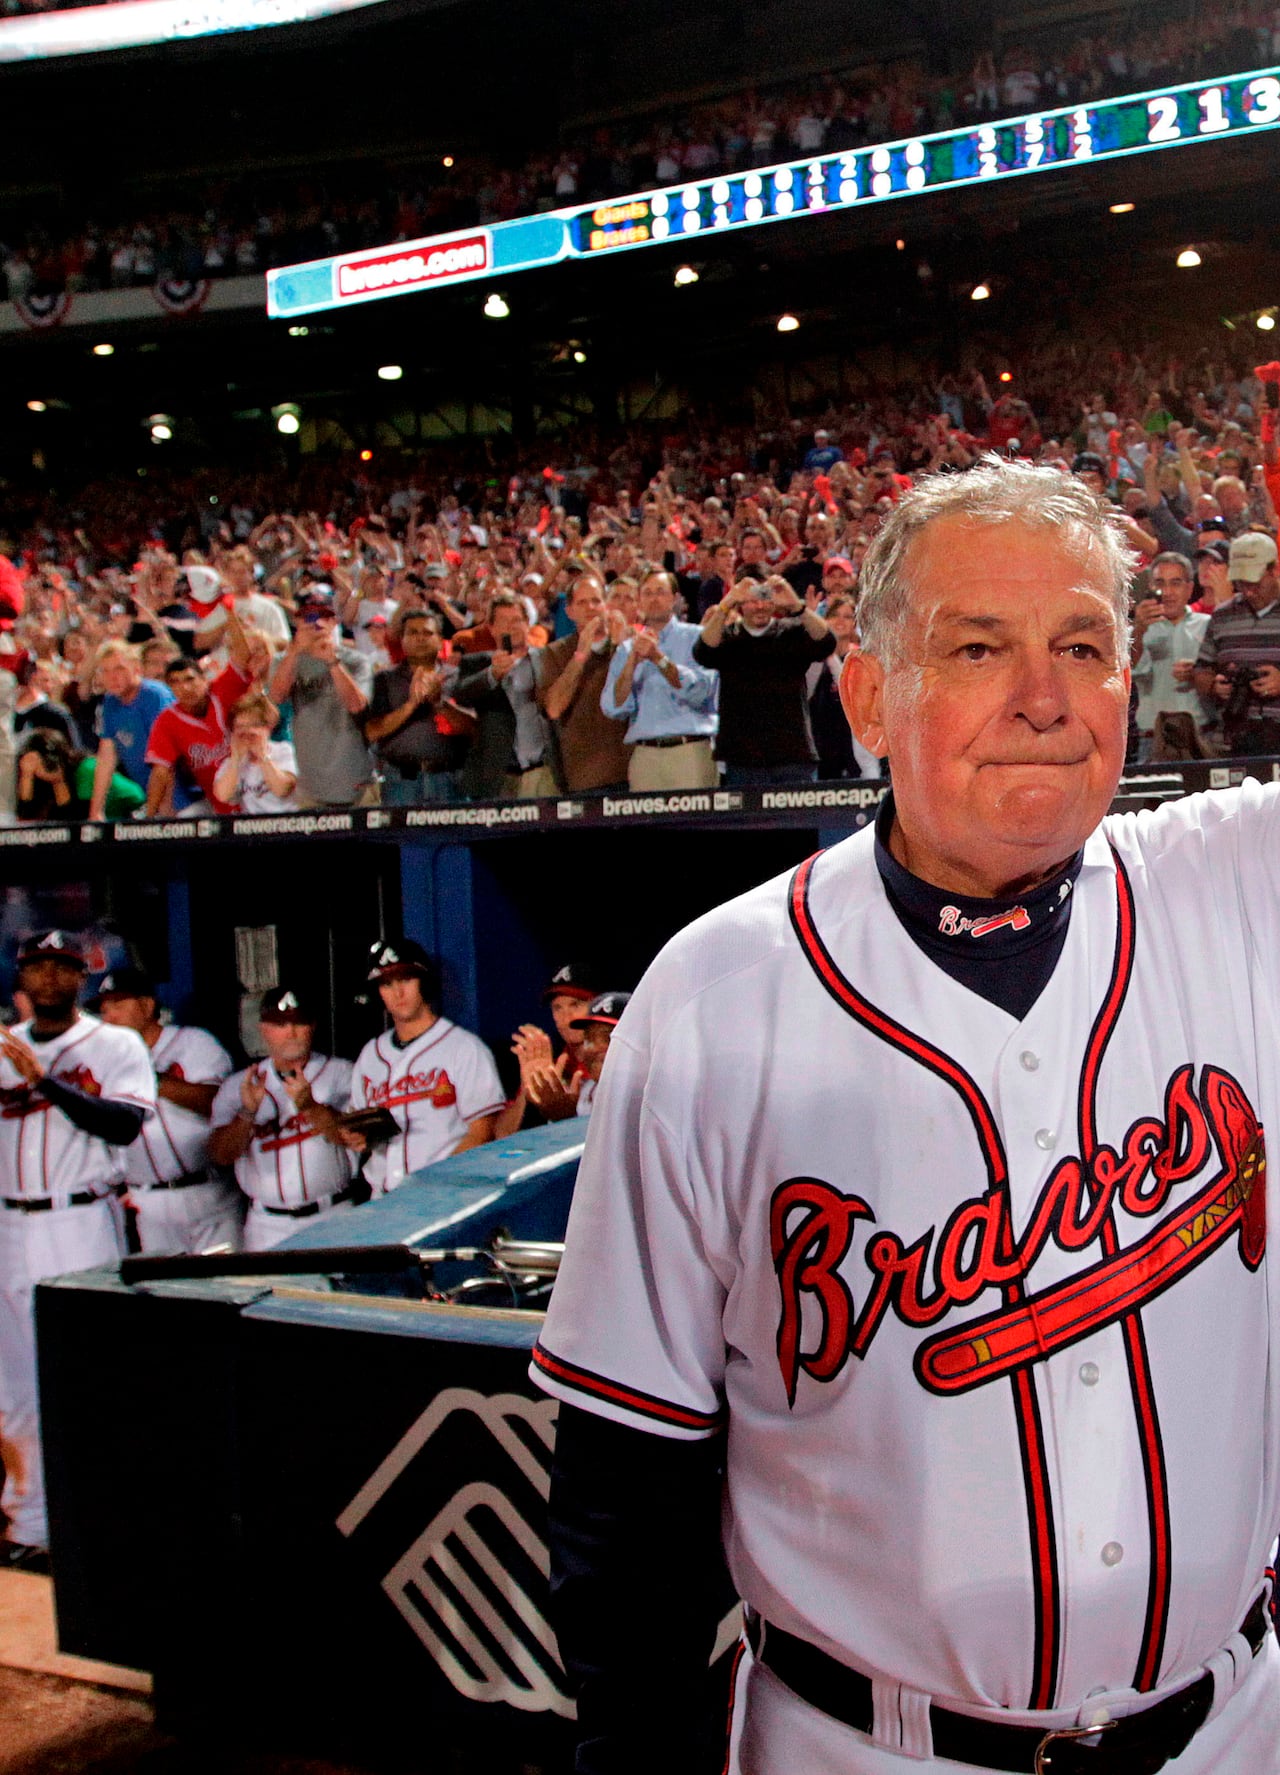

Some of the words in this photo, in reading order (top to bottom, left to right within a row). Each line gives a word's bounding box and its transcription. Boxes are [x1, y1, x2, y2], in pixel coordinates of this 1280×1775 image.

[1147, 97, 1181, 142] 2
[1198, 88, 1230, 133] 1
[651, 192, 669, 216] 0
[682, 186, 700, 210] 0
[712, 180, 730, 204] 0
[744, 174, 762, 197] 0
[774, 167, 793, 191] 0
[808, 161, 826, 185] 1
[839, 154, 857, 179] 2
[872, 148, 891, 172] 0
[905, 141, 925, 166] 0
[978, 127, 996, 152] 3
[1024, 118, 1044, 143] 5
[1073, 109, 1092, 134] 1
[590, 225, 649, 250] Braves
[651, 216, 669, 240] 0
[683, 210, 701, 233] 0
[713, 204, 730, 228] 1
[745, 198, 763, 222] 0
[775, 192, 794, 216] 0
[809, 185, 826, 209] 1
[839, 179, 858, 203] 0
[872, 172, 891, 196] 0
[906, 166, 926, 190] 0
[979, 152, 998, 176] 2
[1025, 143, 1045, 168] 7
[1074, 134, 1093, 158] 2
[340, 243, 485, 294] braves.com
[114, 822, 196, 840] braves.com
[233, 814, 351, 835] neweracap.com
[406, 805, 539, 828] neweracap.com
[603, 795, 710, 817] braves.com
[770, 1063, 1210, 1411] Braves
